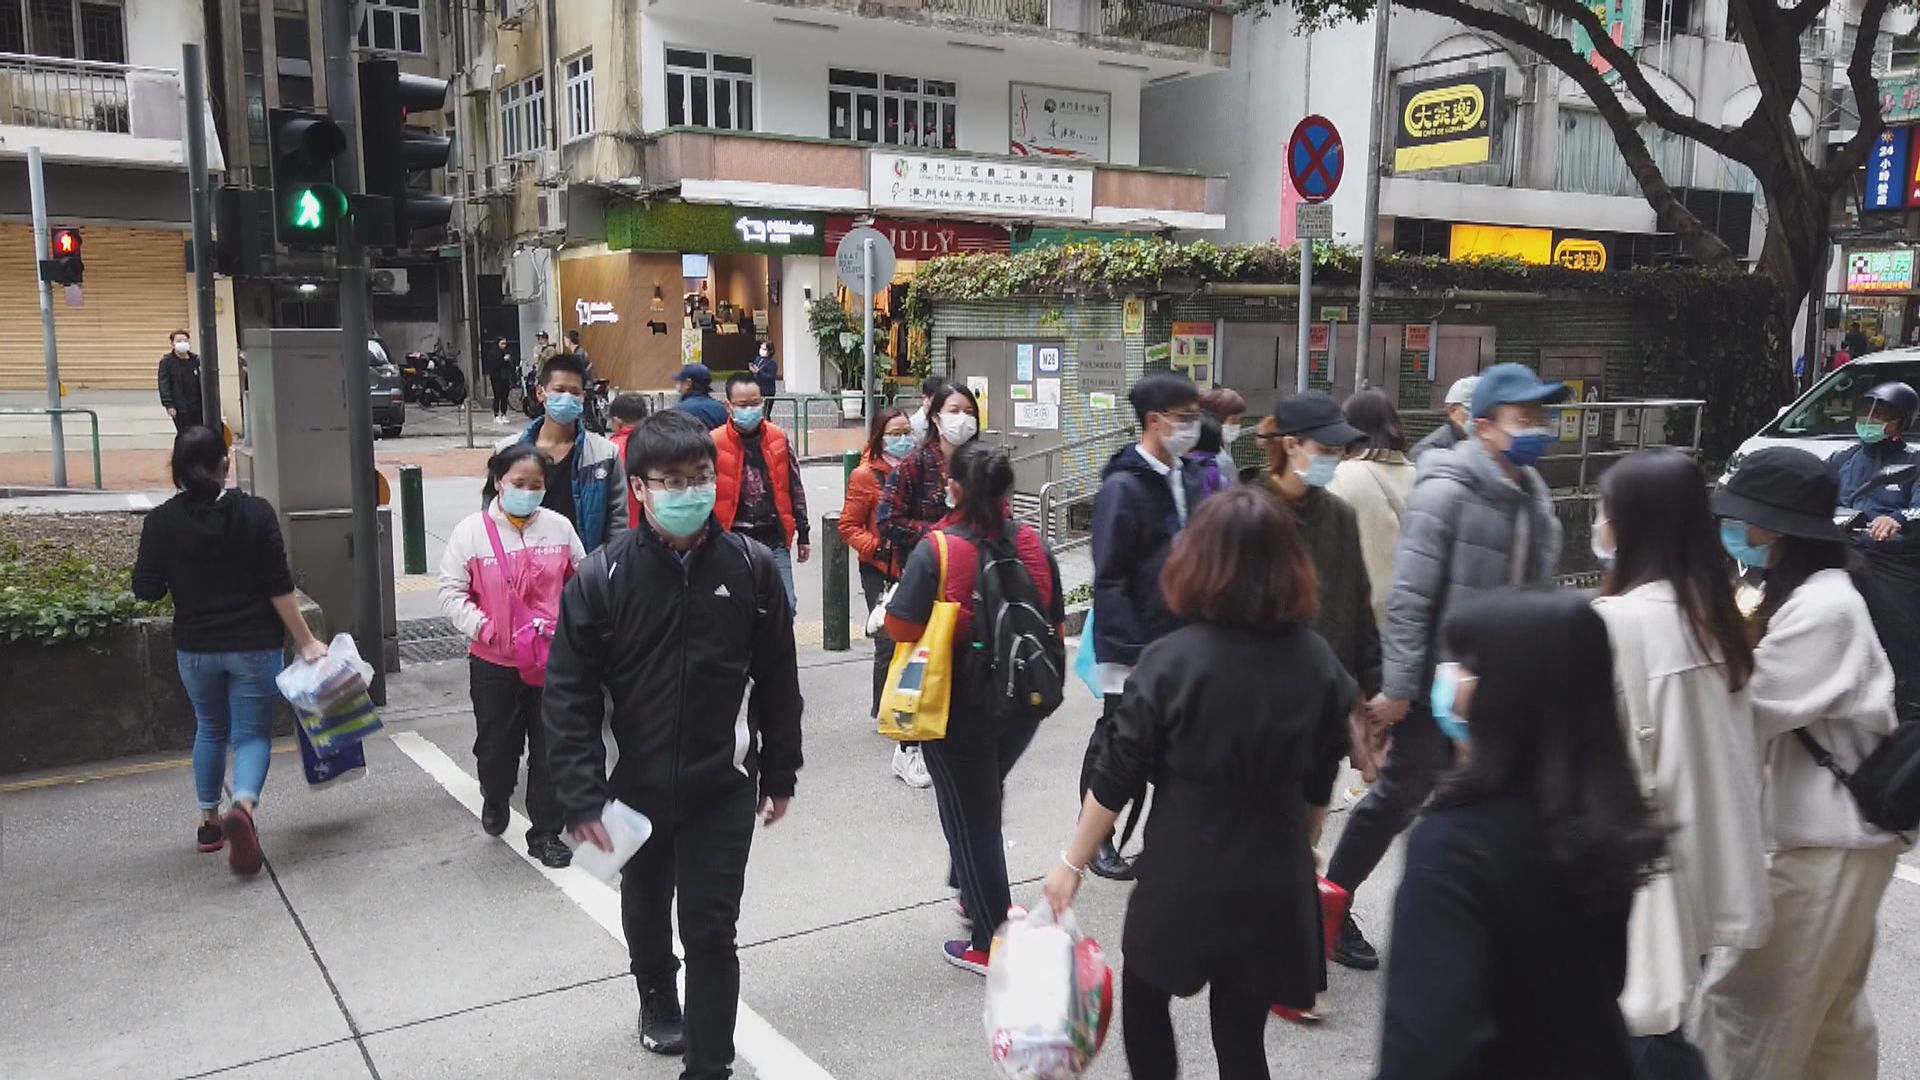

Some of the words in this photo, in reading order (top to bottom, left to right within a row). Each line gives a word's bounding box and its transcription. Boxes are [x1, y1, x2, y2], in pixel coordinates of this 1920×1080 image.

[1415, 98, 1472, 130] 大家樂
[889, 228, 955, 253] JULY
